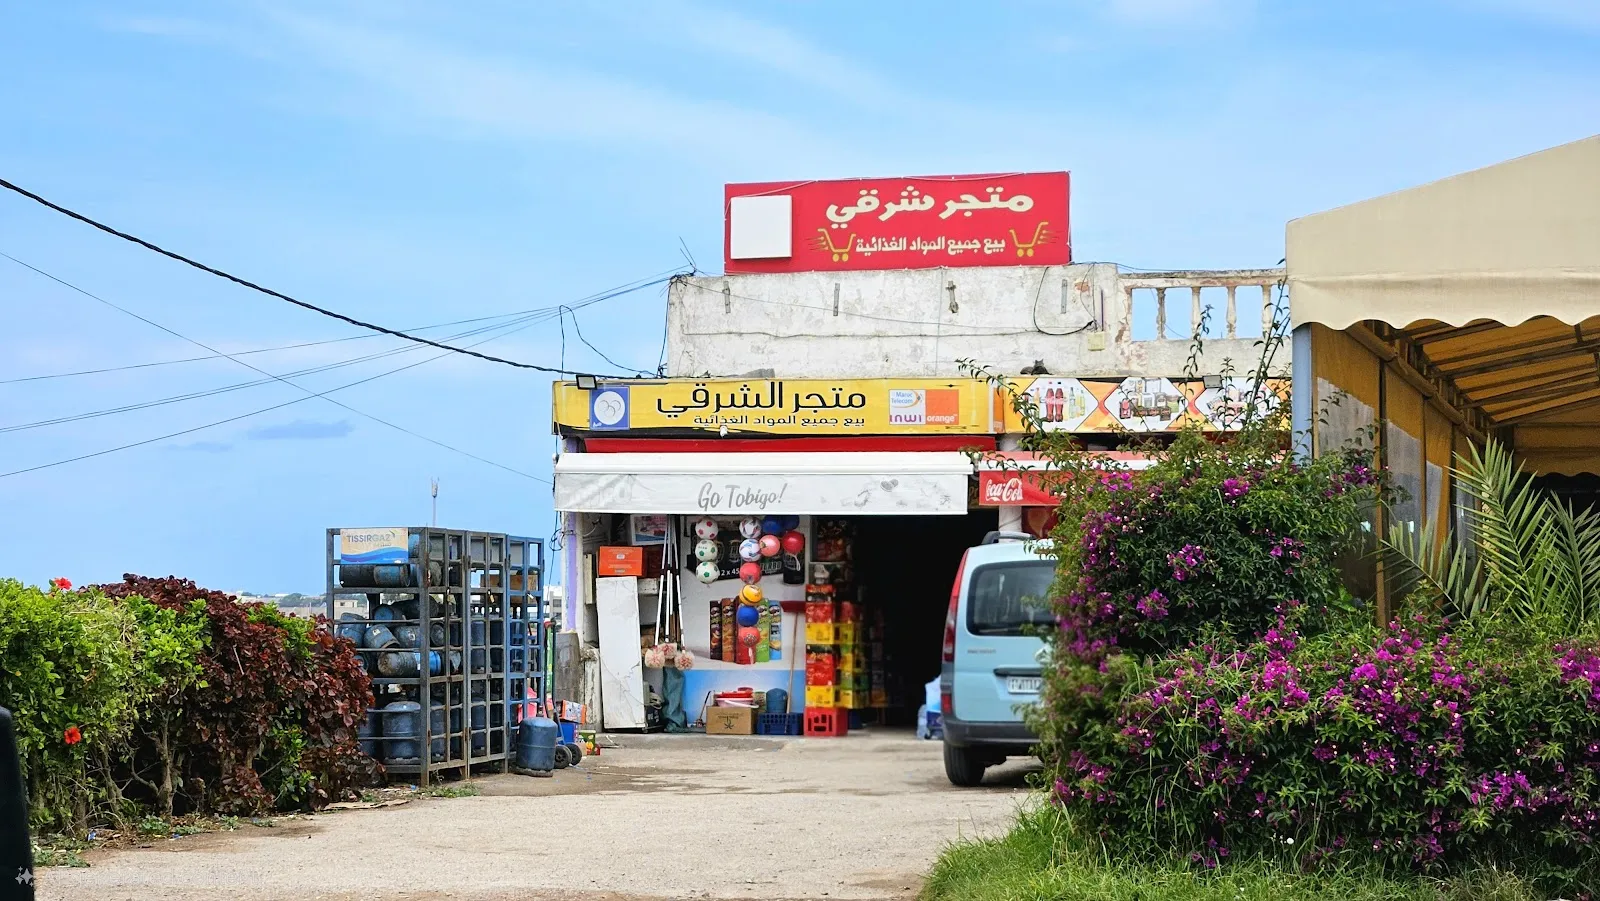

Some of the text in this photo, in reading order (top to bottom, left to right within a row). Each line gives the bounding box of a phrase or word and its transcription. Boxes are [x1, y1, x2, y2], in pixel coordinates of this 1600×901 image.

[826, 185, 1034, 229] متجر شرقي
[855, 236, 1006, 256] بيع جميع المواد الغذائية
[656, 382, 866, 418] متجر الشرقي
[693, 415, 865, 427] بيع جميع المواد الغذائية
[698, 482, 788, 512] Go Tobigo!
[346, 534, 391, 543] TISSIRGAZ
